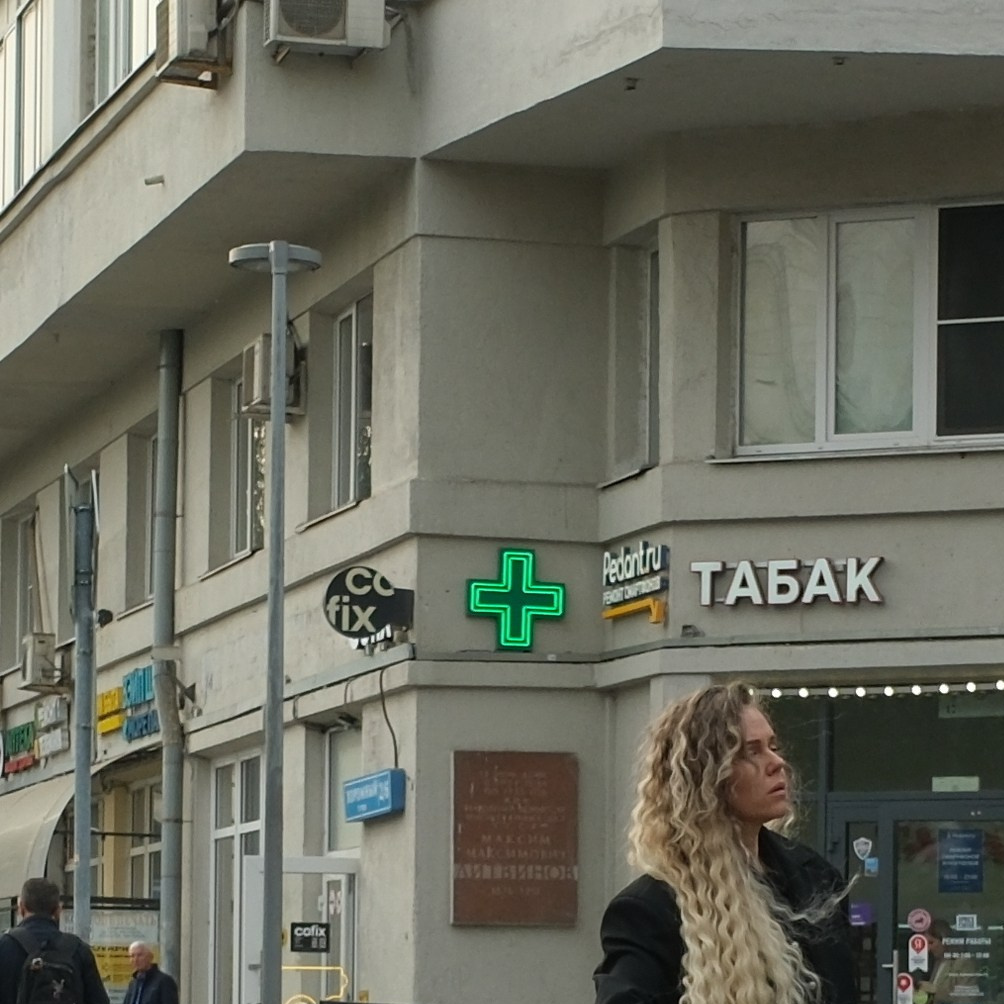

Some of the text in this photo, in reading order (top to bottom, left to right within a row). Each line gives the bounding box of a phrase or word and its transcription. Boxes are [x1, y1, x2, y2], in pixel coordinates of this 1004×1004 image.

[690, 557, 882, 607] ТАБАК
[326, 594, 376, 633] fix
[294, 924, 327, 938] cofix
